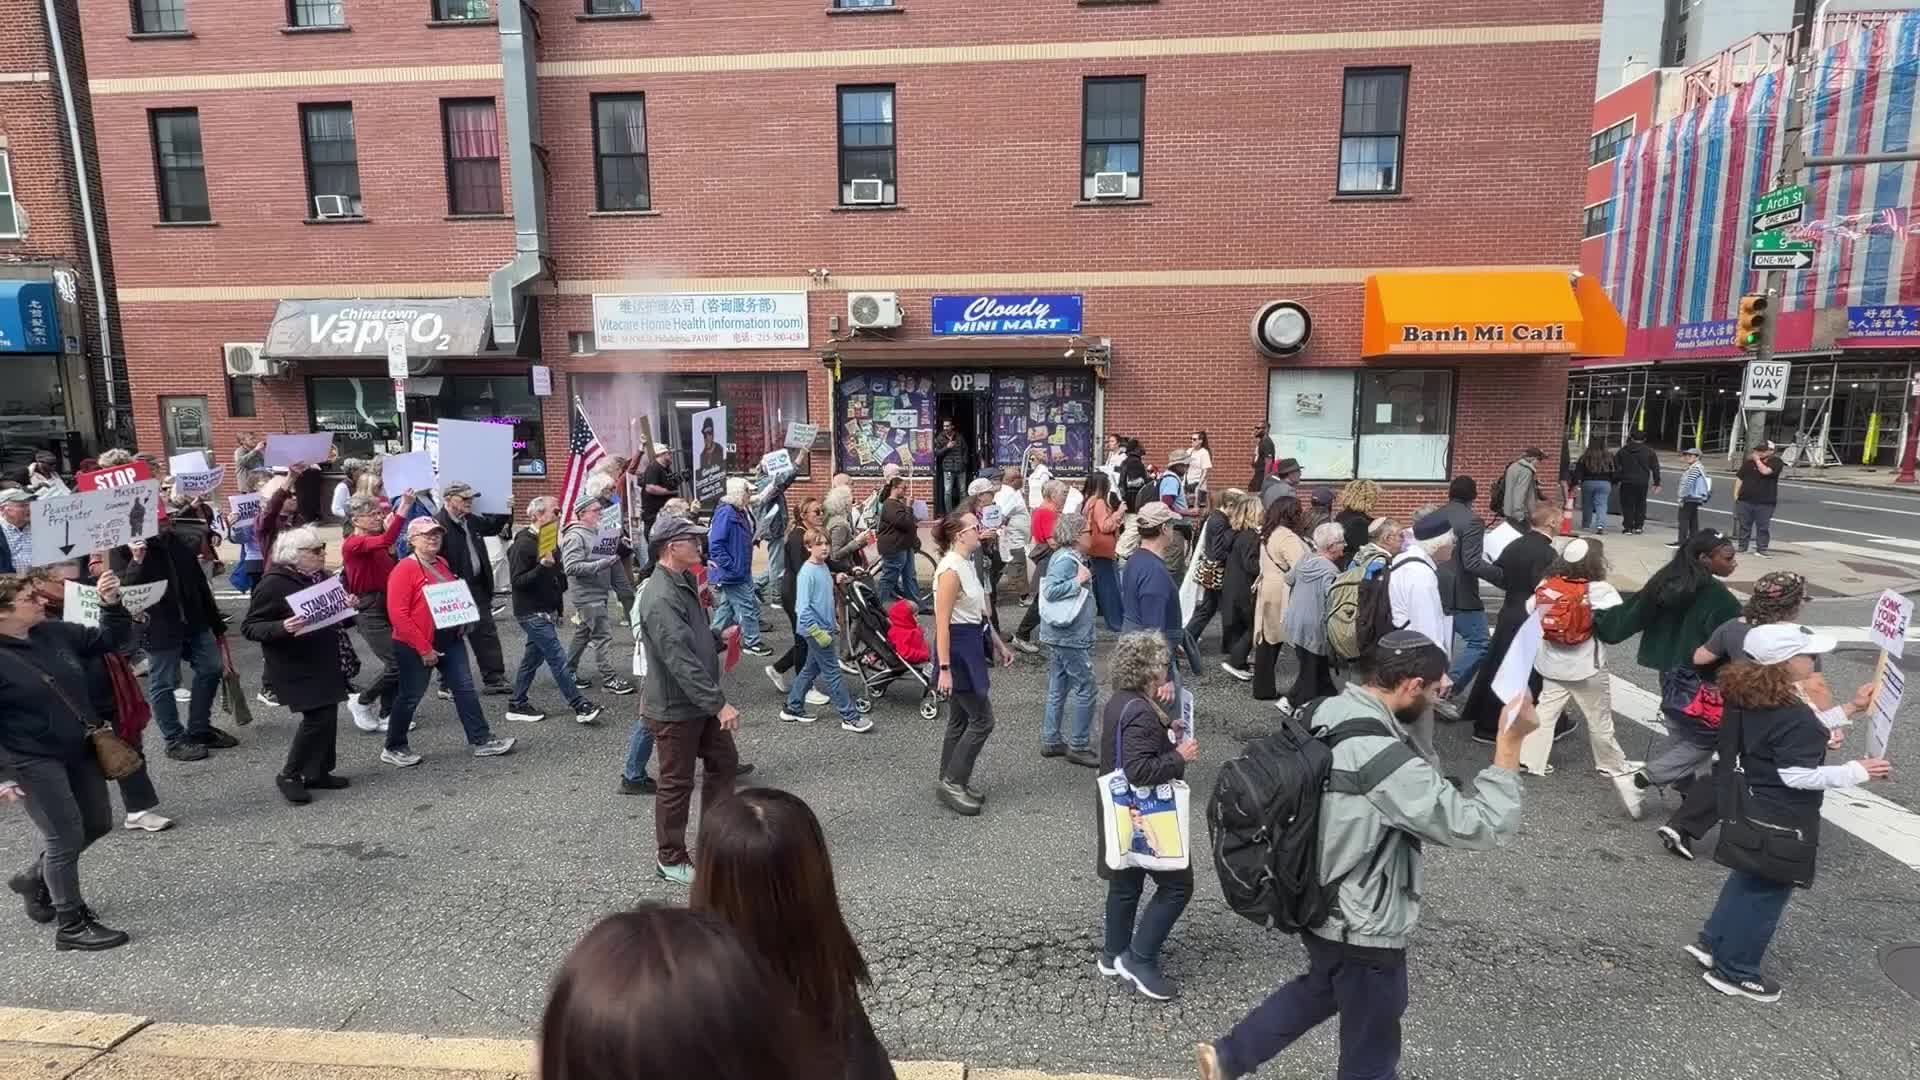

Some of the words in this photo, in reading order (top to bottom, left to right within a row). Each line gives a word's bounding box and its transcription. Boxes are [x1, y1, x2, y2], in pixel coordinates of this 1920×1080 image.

[1766, 196, 1789, 211] Arch
[1793, 192, 1802, 203] St
[1766, 216, 1780, 226] ONE
[1782, 209, 1797, 220] WAY
[1757, 255, 1774, 264] ONE
[1777, 255, 1794, 264] WAY
[340, 308, 418, 320] Chinatown
[963, 296, 1050, 322] Cloudy
[600, 318, 640, 331] Vitacare
[642, 318, 672, 331] Home
[674, 316, 706, 331] Health
[708, 315, 770, 333] (information
[773, 314, 804, 331] room)
[953, 319, 999, 333] MINI
[1003, 318, 1061, 332] MART
[1403, 326, 1468, 342] Banh
[1474, 325, 1505, 341] Mi
[1511, 325, 1564, 341] Cali
[1753, 365, 1784, 377] ONE
[1751, 378, 1782, 390] WAY
[94, 467, 137, 490] STOP
[41, 499, 83, 516] Peaceful
[48, 509, 93, 528] Protester
[300, 593, 328, 616] STAND
[433, 601, 474, 615] AMERICA
[1880, 598, 1900, 614] HONK
[1877, 607, 1896, 624] YOUR
